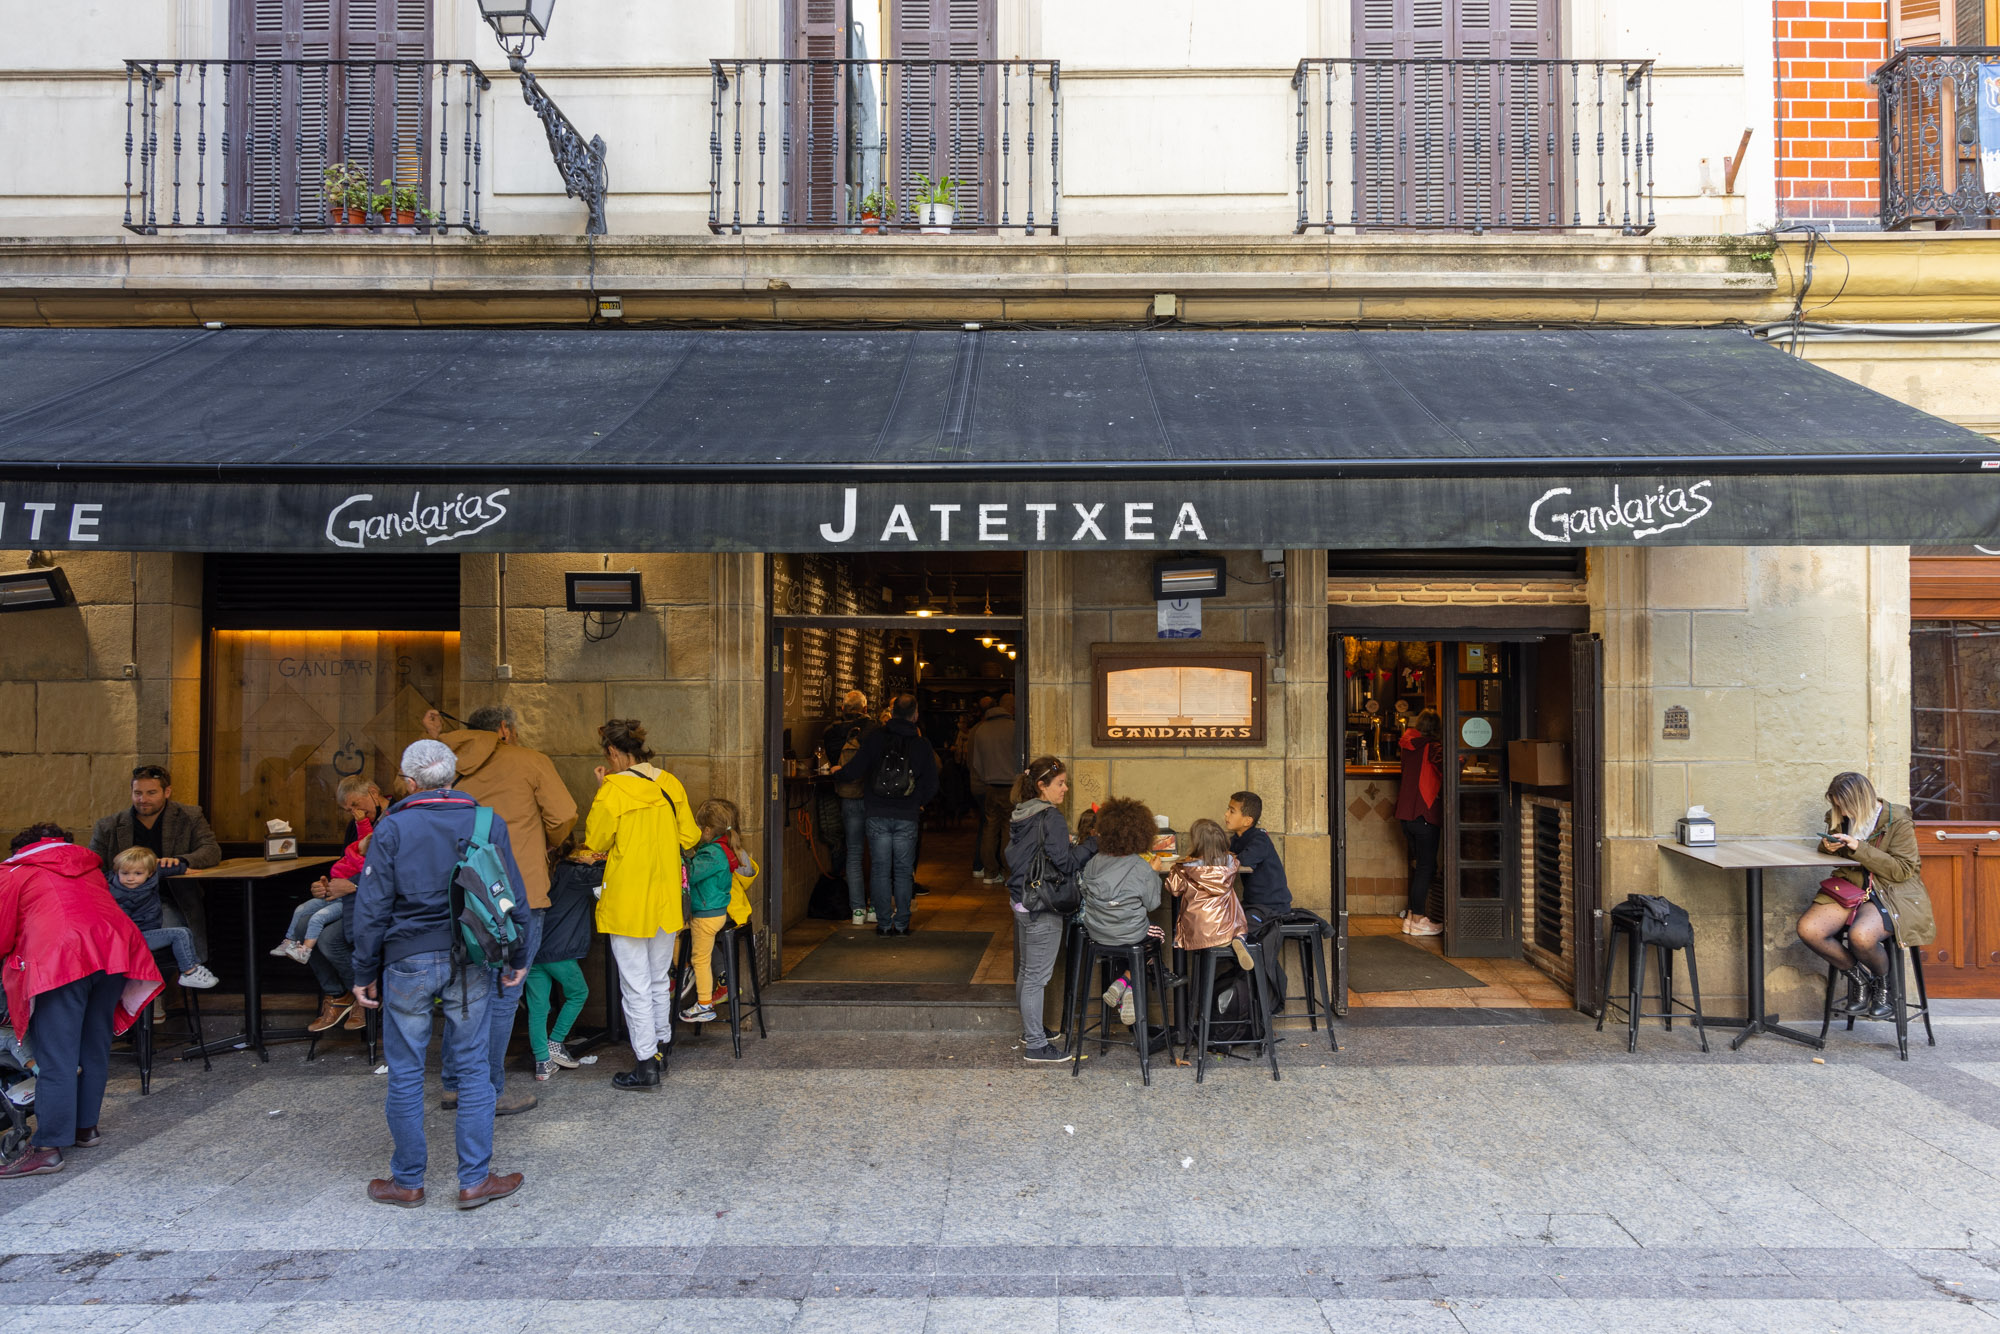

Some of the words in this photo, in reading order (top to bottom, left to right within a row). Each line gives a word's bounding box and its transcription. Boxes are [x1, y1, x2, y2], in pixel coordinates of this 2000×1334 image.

[326, 488, 510, 548] Gandarias
[819, 488, 1208, 542] JATETXEA
[1529, 480, 1712, 542] Gandarias
